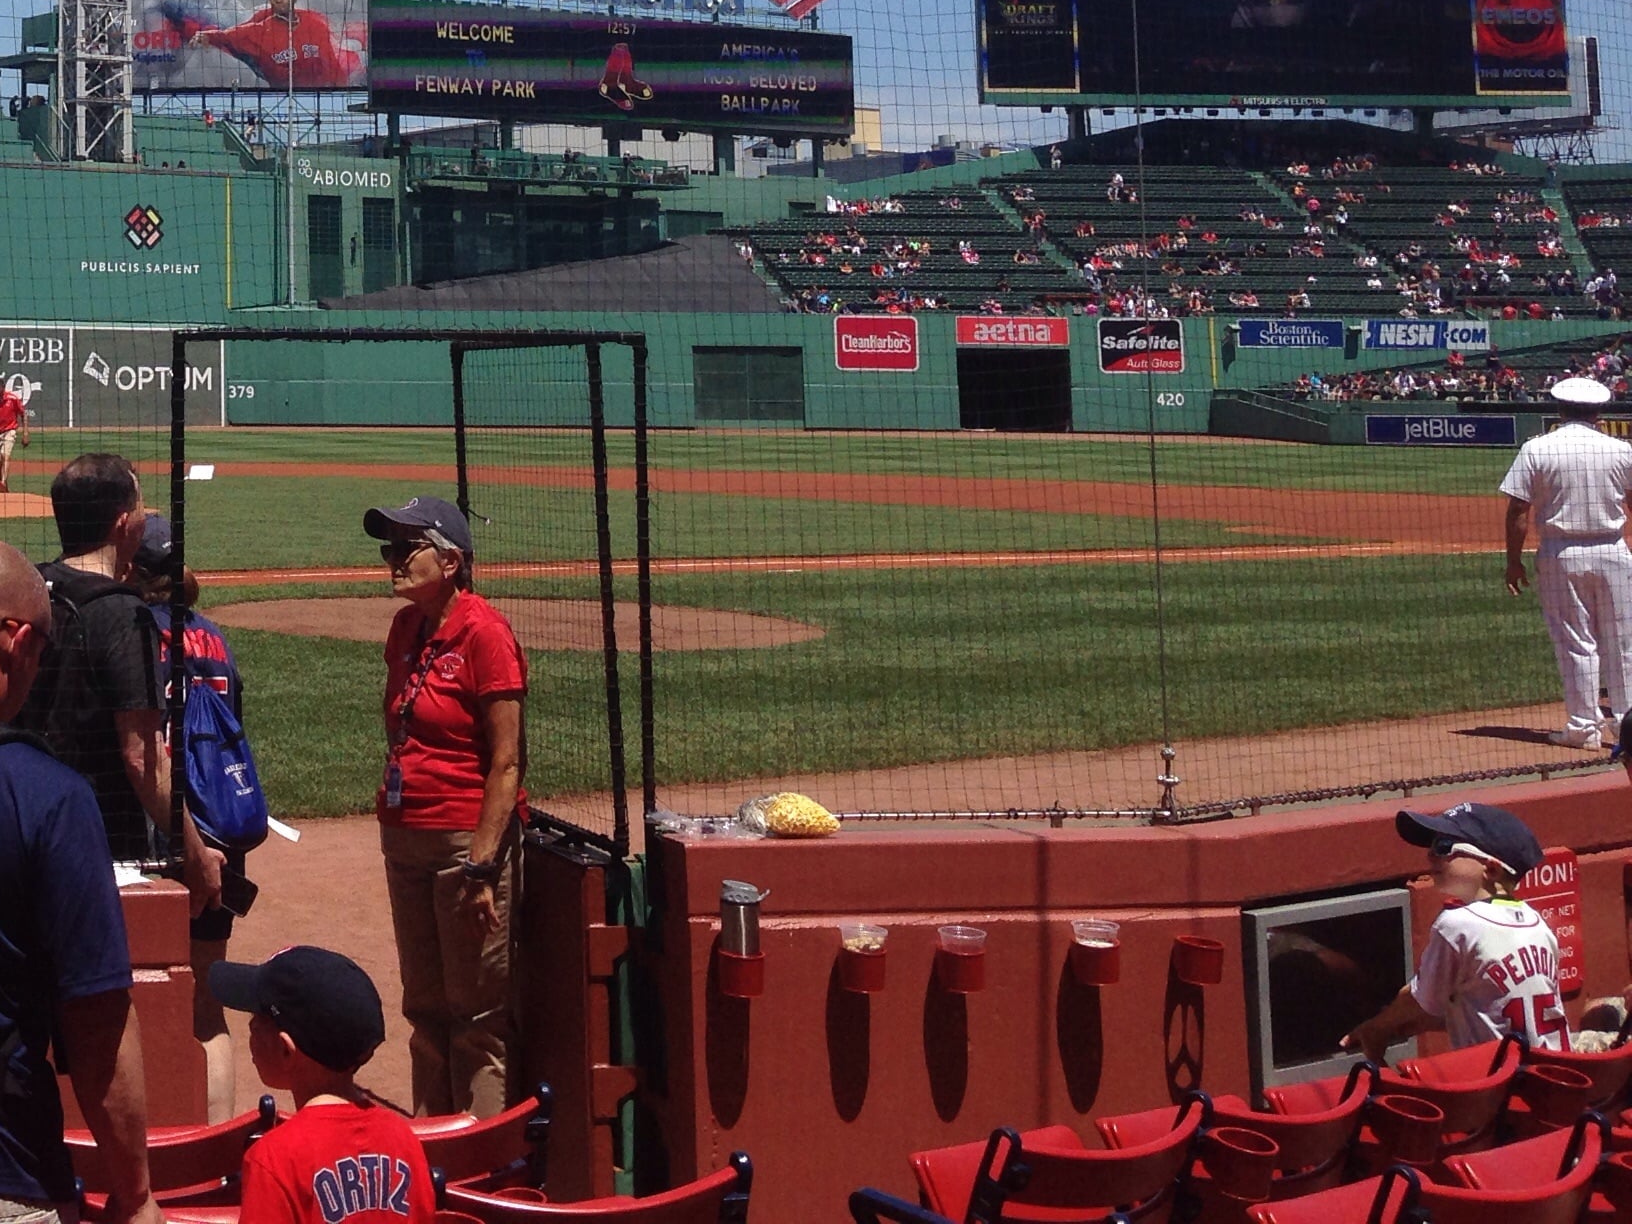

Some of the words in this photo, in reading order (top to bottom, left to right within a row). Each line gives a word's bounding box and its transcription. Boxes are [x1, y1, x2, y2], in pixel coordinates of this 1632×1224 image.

[1006, 4, 1056, 15] DRAFT
[1008, 15, 1055, 25] KINGS
[436, 21, 514, 44] WELCOME
[607, 22, 637, 36] 12:57
[1502, 69, 1544, 78] MOTOR
[415, 74, 484, 96] FENWAY
[491, 77, 536, 99] PARK
[749, 73, 817, 92] BELOVED
[721, 94, 801, 116] BALLPARK
[312, 169, 392, 188] ABIOMED
[80, 261, 140, 273] PUBLICIS
[142, 262, 200, 275] SAPIENT
[974, 321, 1051, 342] aetna
[1269, 322, 1312, 334] Boston
[1379, 323, 1435, 346] NESN
[1102, 335, 1180, 350] Safelite
[1259, 331, 1329, 346] Scientific
[228, 386, 255, 399] 379
[1156, 392, 1185, 406] 420
[1403, 417, 1476, 442] jetBlue
[1558, 904, 1576, 917] NET
[1556, 925, 1576, 938] FOR
[313, 1154, 412, 1224] ORTIZ
